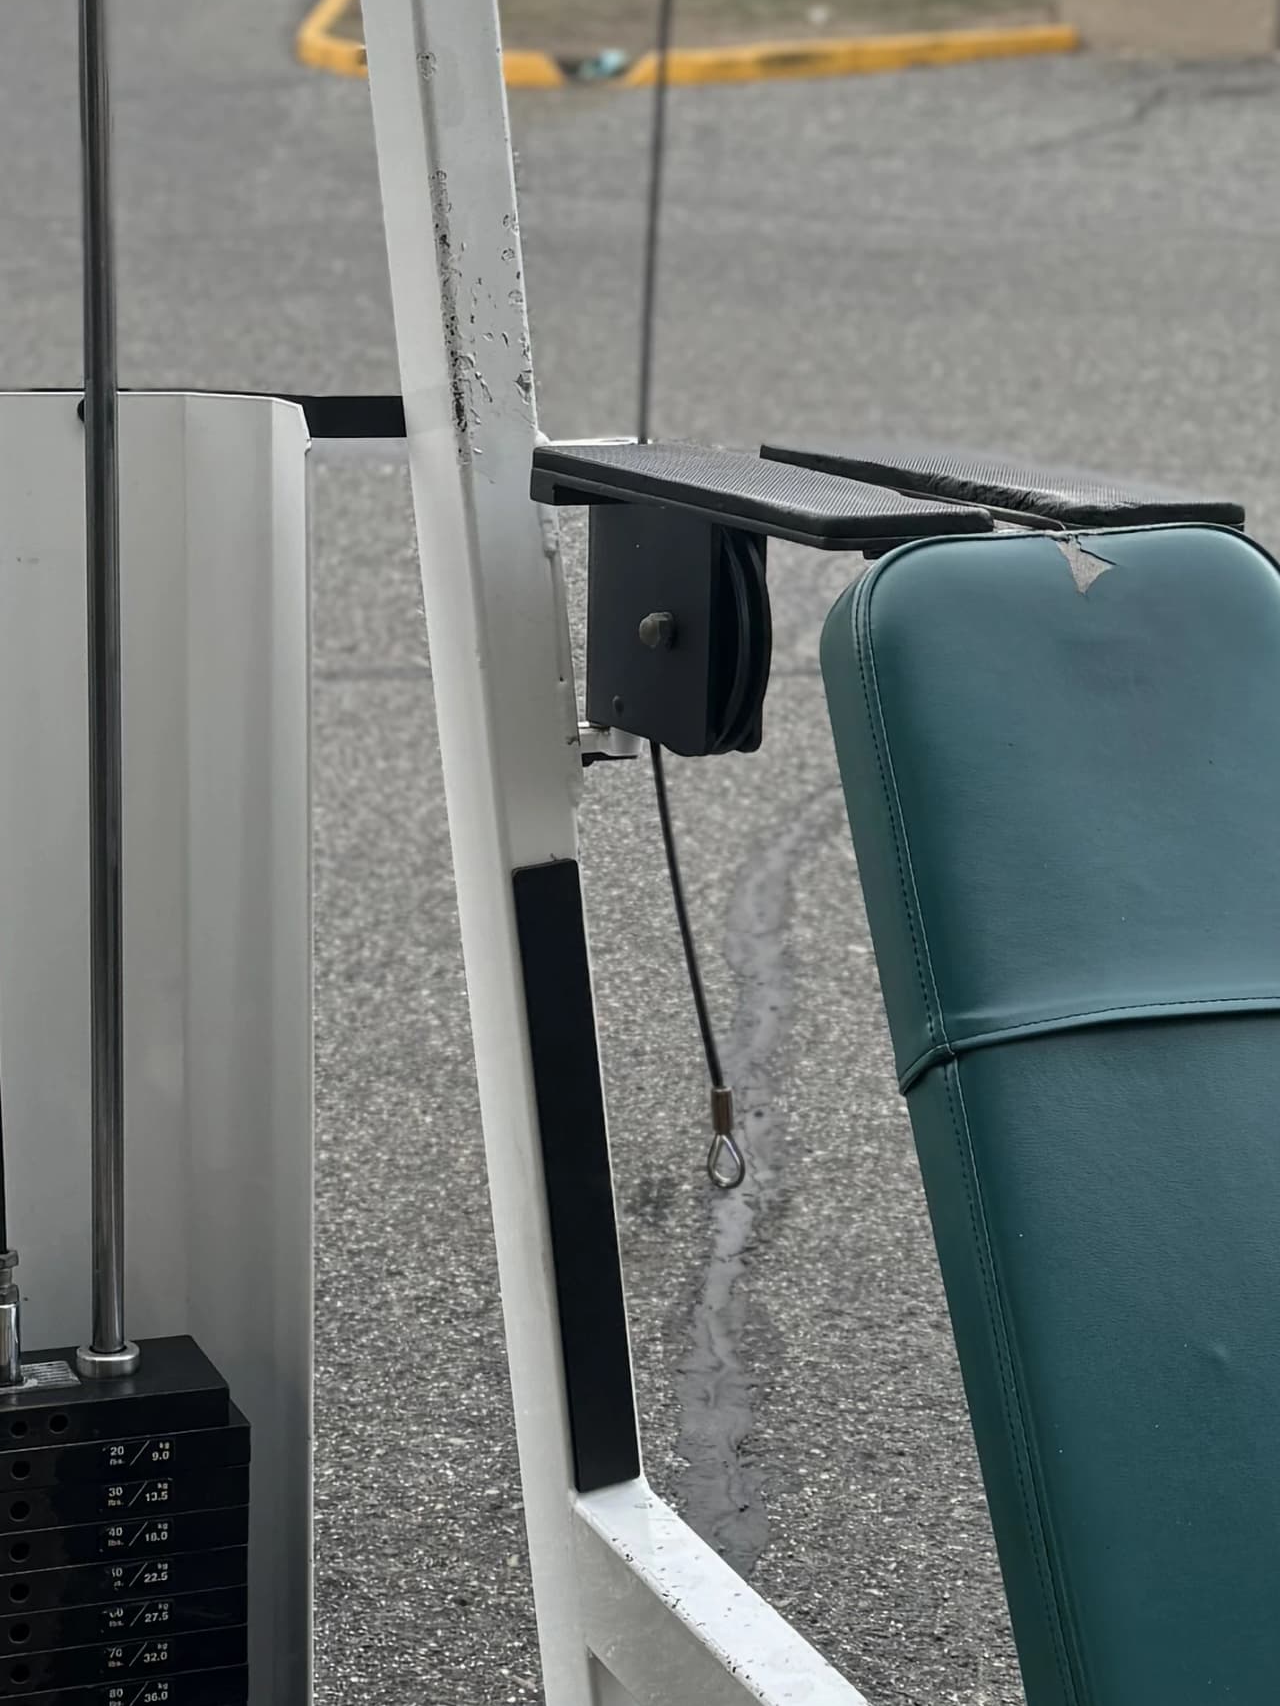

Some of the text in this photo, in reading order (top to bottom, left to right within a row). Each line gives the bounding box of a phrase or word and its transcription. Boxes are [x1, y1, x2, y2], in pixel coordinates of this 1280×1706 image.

[110, 1446, 125, 1456] 20
[108, 1487, 123, 1497] 30
[108, 1527, 123, 1536] 40
[108, 1647, 123, 1658] 70
[109, 1688, 124, 1698] 80
